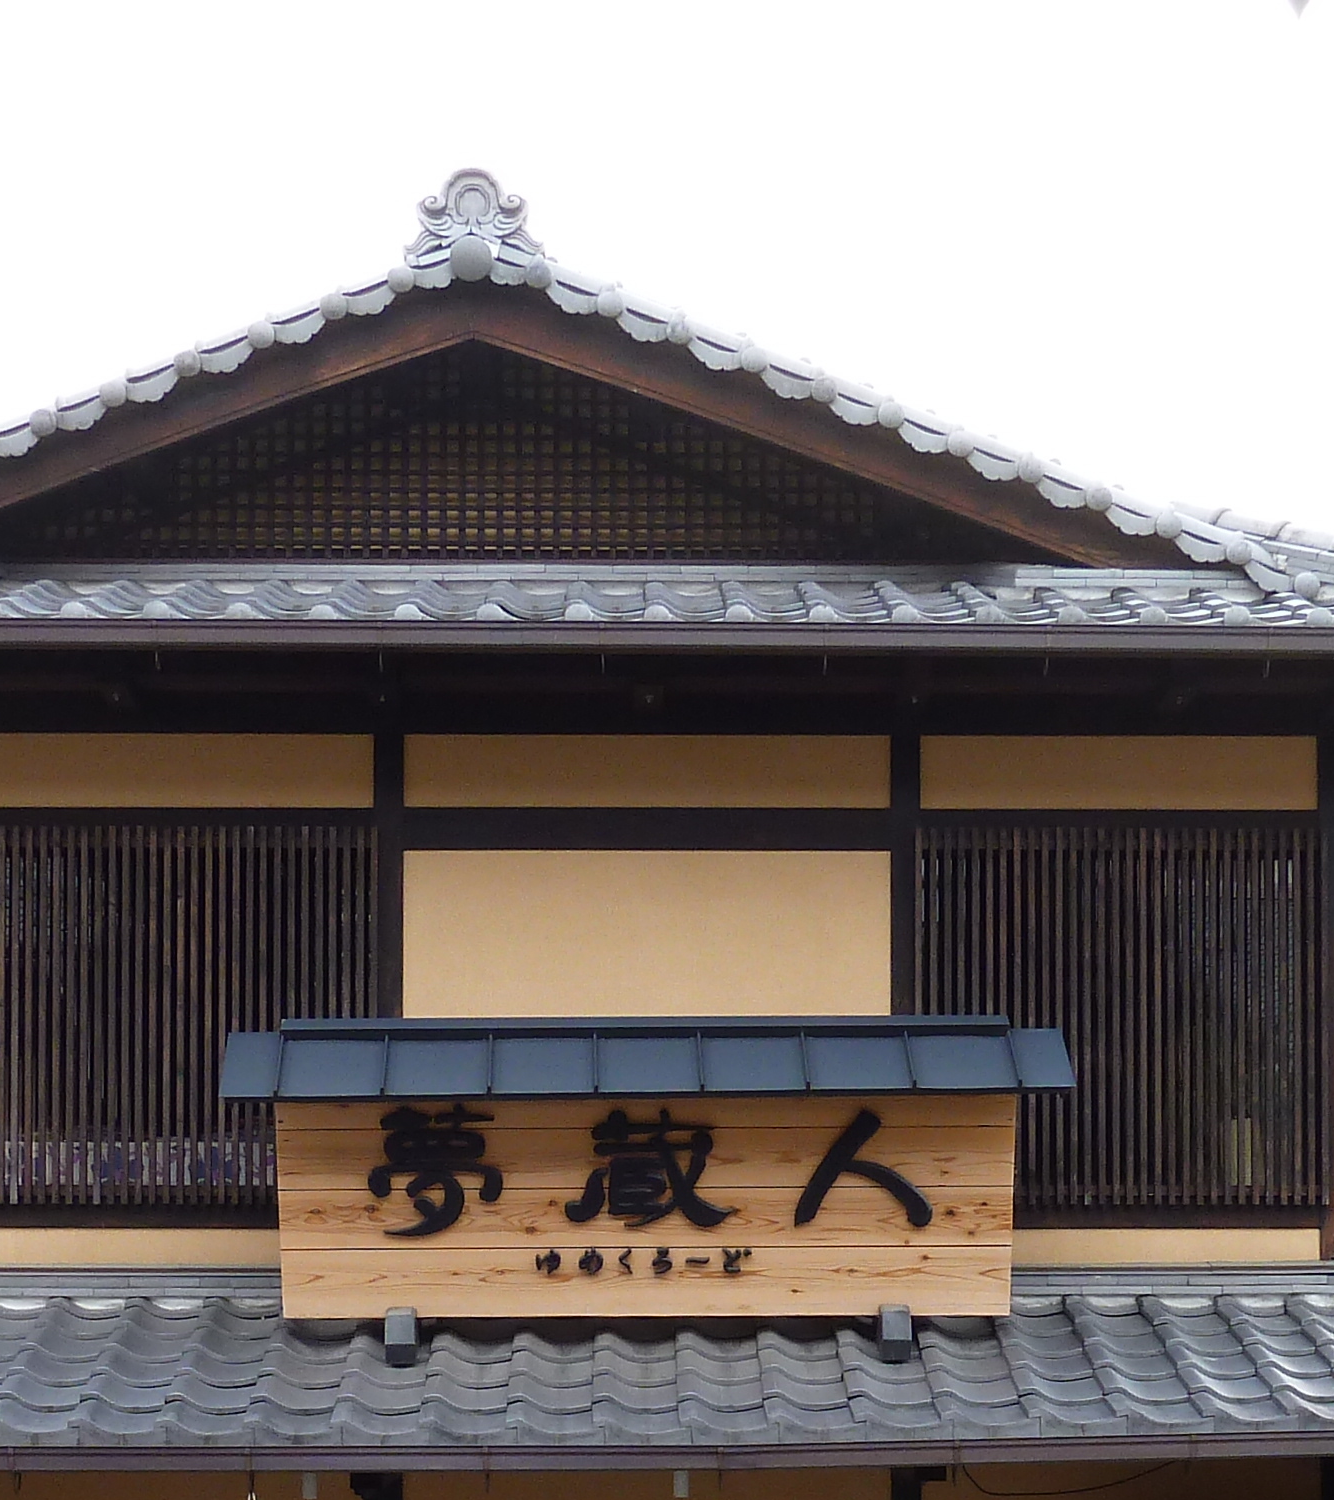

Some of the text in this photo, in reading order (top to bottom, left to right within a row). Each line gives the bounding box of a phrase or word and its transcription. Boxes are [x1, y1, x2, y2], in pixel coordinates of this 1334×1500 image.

[367, 1103, 933, 1238] 夢蔵人
[535, 1246, 753, 1276] ゆめくらーど
